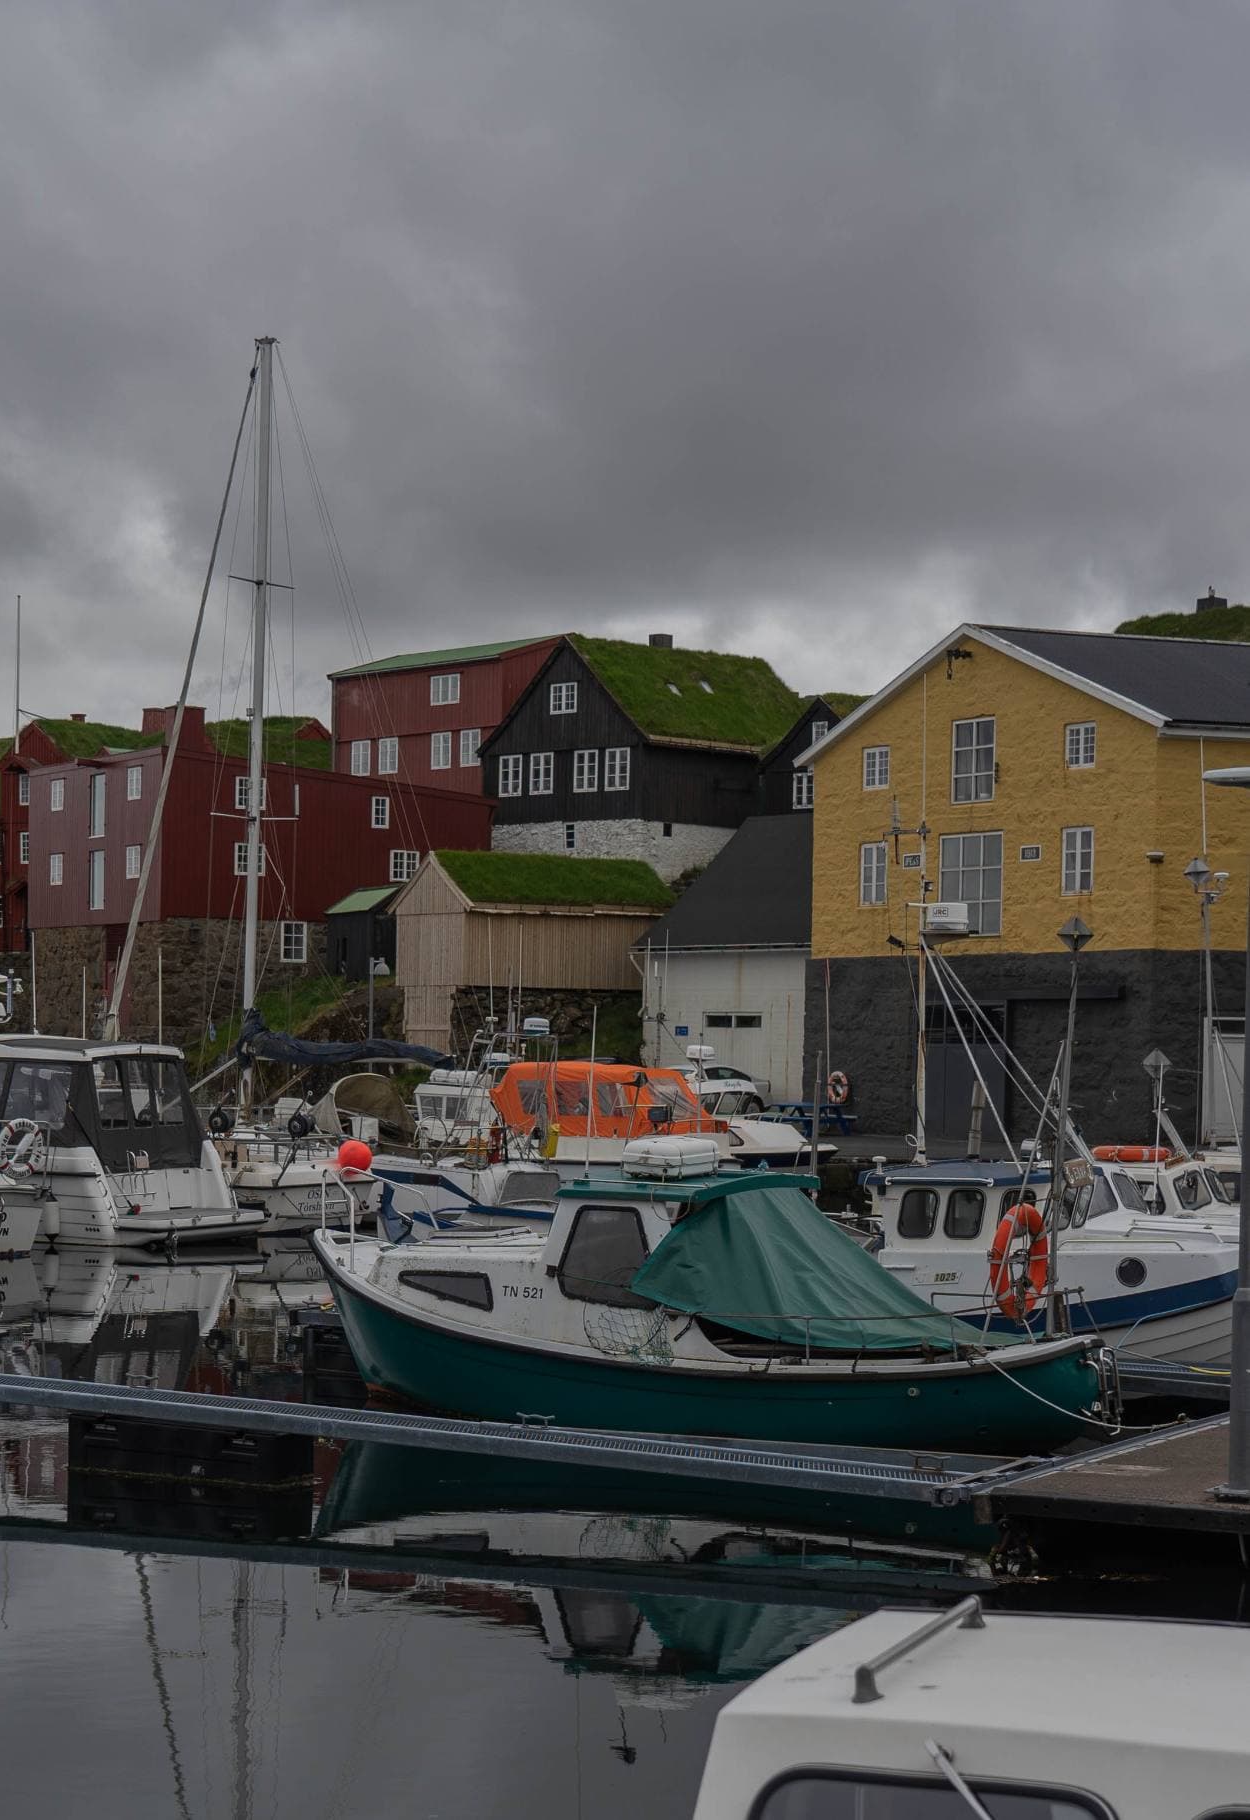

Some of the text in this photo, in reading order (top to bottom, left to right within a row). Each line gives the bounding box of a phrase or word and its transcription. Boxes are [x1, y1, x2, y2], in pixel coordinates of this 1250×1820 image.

[298, 1201, 335, 1212] Tórshvn
[502, 1285, 543, 1299] TN 521
